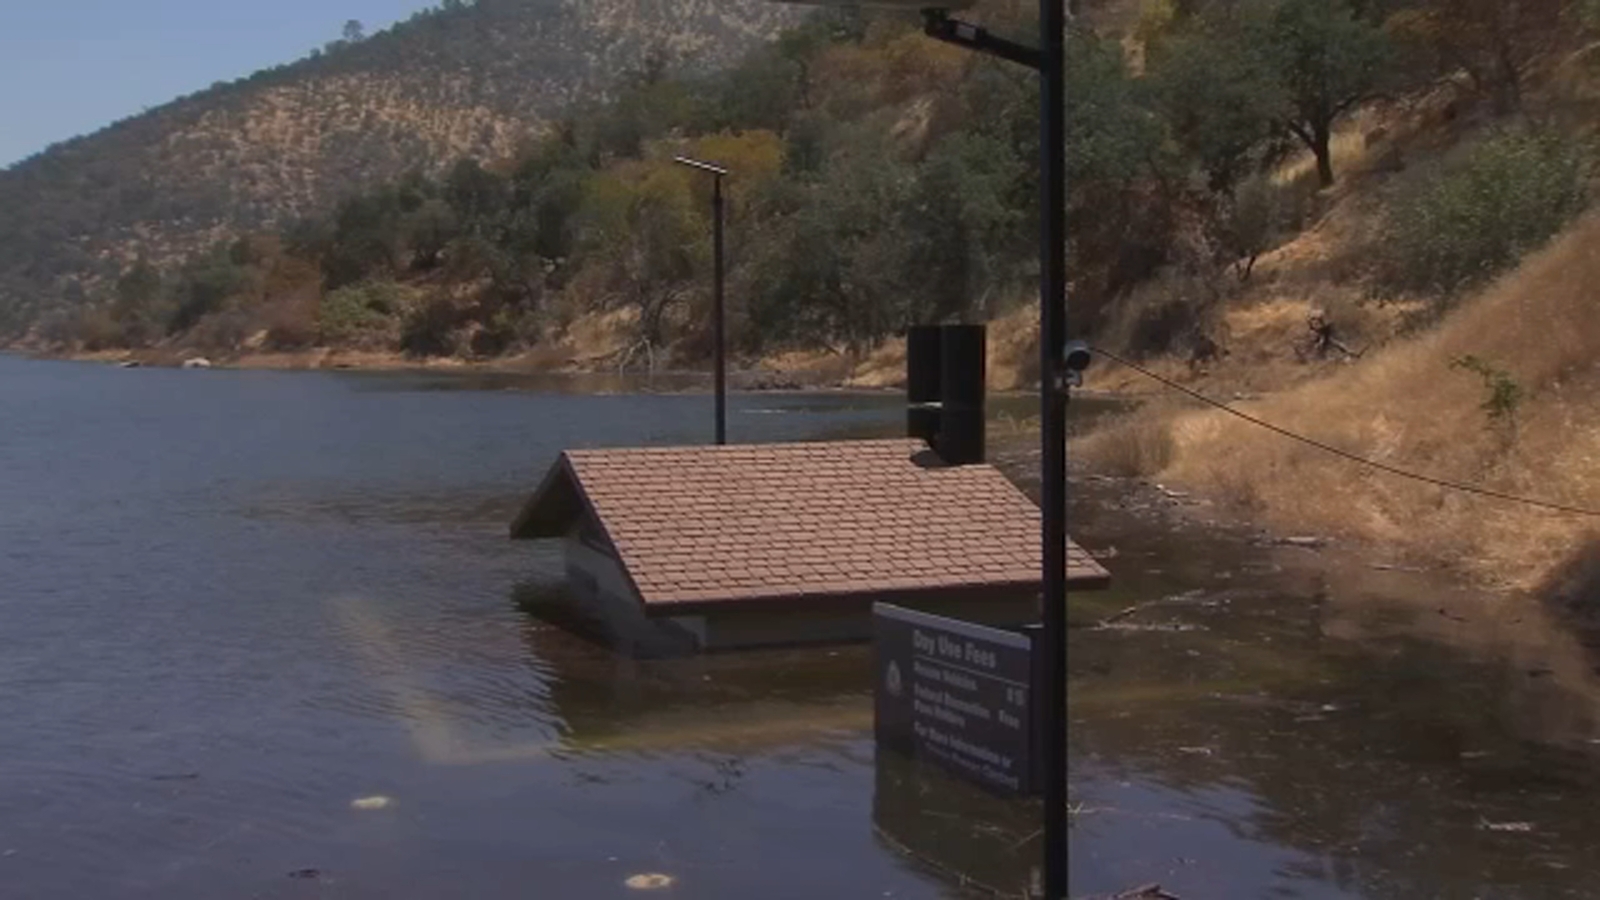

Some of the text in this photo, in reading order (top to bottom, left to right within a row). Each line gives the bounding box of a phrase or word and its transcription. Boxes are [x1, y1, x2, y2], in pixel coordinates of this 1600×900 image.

[913, 629, 997, 669] Day Use Fees
